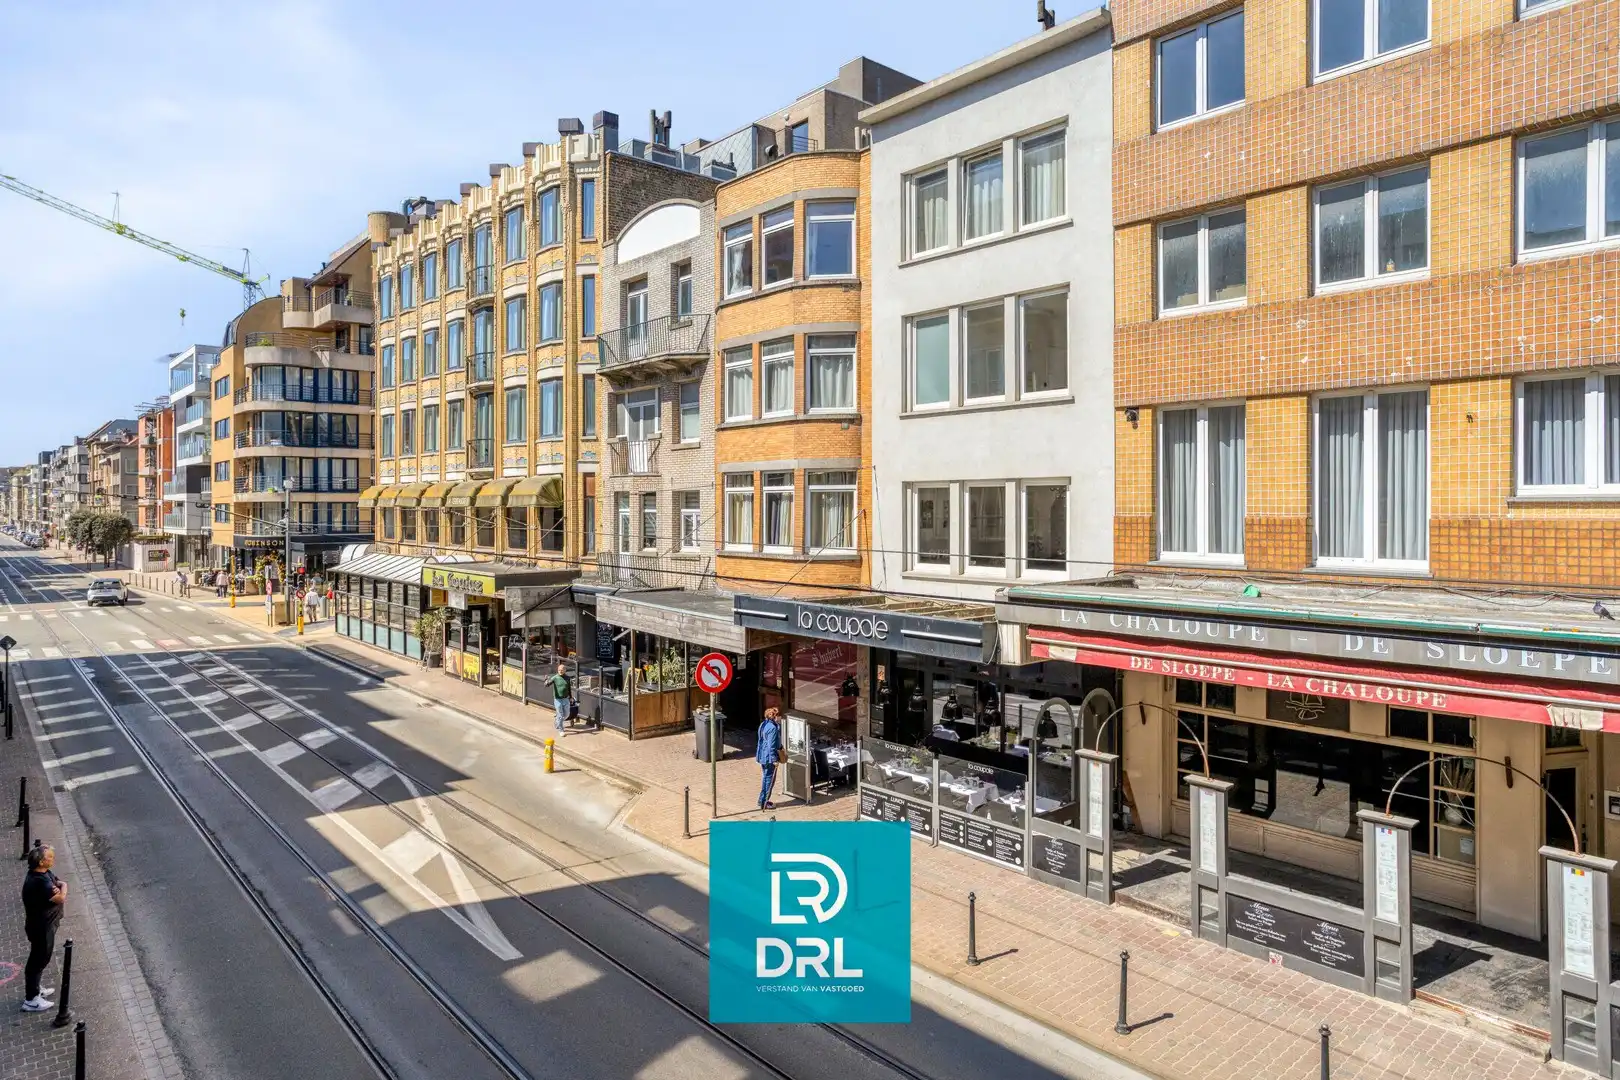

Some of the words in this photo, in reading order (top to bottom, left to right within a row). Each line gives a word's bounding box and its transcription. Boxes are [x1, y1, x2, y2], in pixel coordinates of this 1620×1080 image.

[797, 606, 812, 630] la
[816, 612, 889, 640] coupole
[1060, 609, 1087, 624] LA
[1109, 613, 1265, 641] CHALOUPE
[1344, 634, 1389, 654] DE
[1427, 641, 1612, 675] SLOEPE
[1130, 656, 1154, 671] DE
[1161, 660, 1236, 682] SLOEPE
[1267, 673, 1294, 690] LA
[1305, 677, 1448, 708] CHALOUPE
[890, 796, 905, 806] LUNCH
